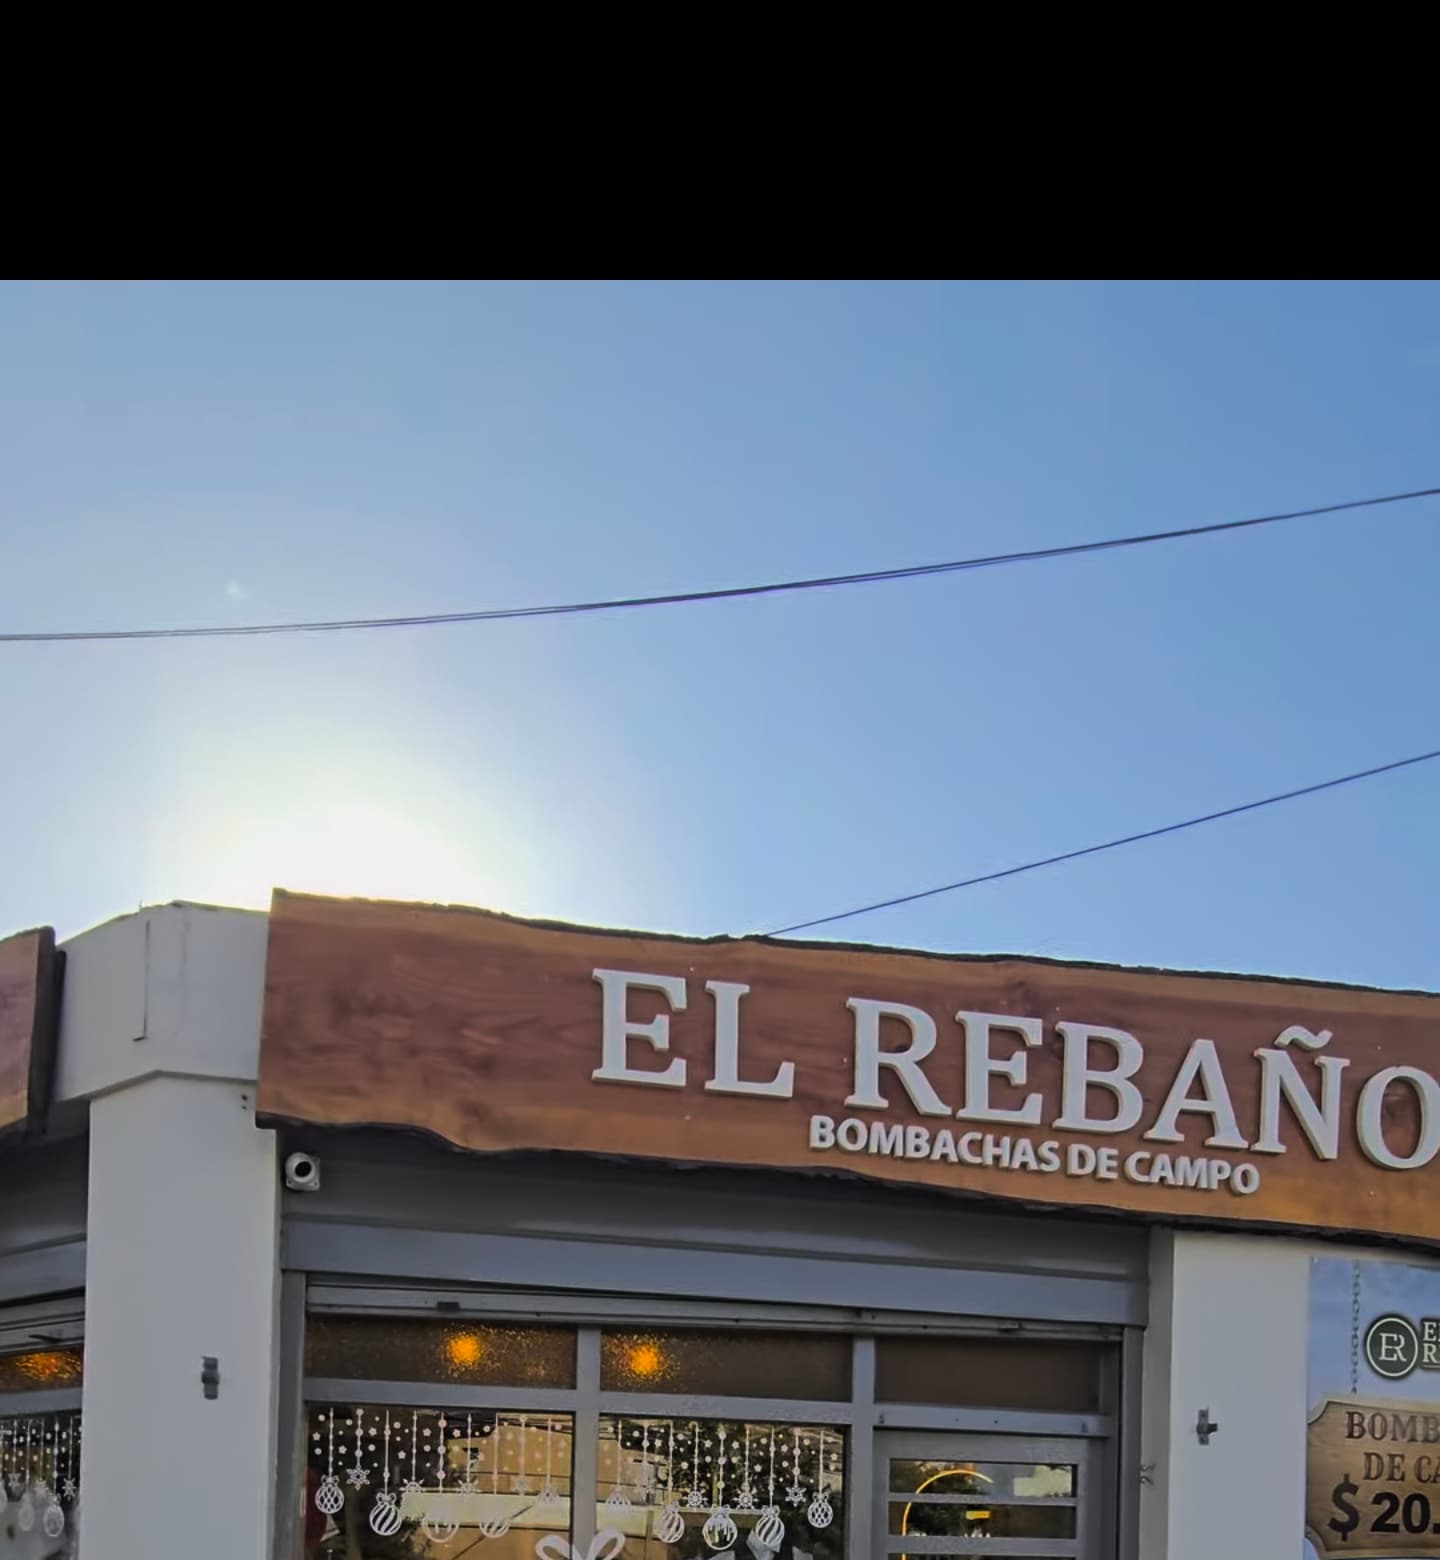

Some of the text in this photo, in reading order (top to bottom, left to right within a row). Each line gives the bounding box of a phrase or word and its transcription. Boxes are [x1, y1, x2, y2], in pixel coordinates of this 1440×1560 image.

[592, 967, 1440, 1171] EL REBAÑO
[809, 1114, 1261, 1196] BOMBACHAS DE CAMPO
[1363, 1451, 1406, 1483] DE
